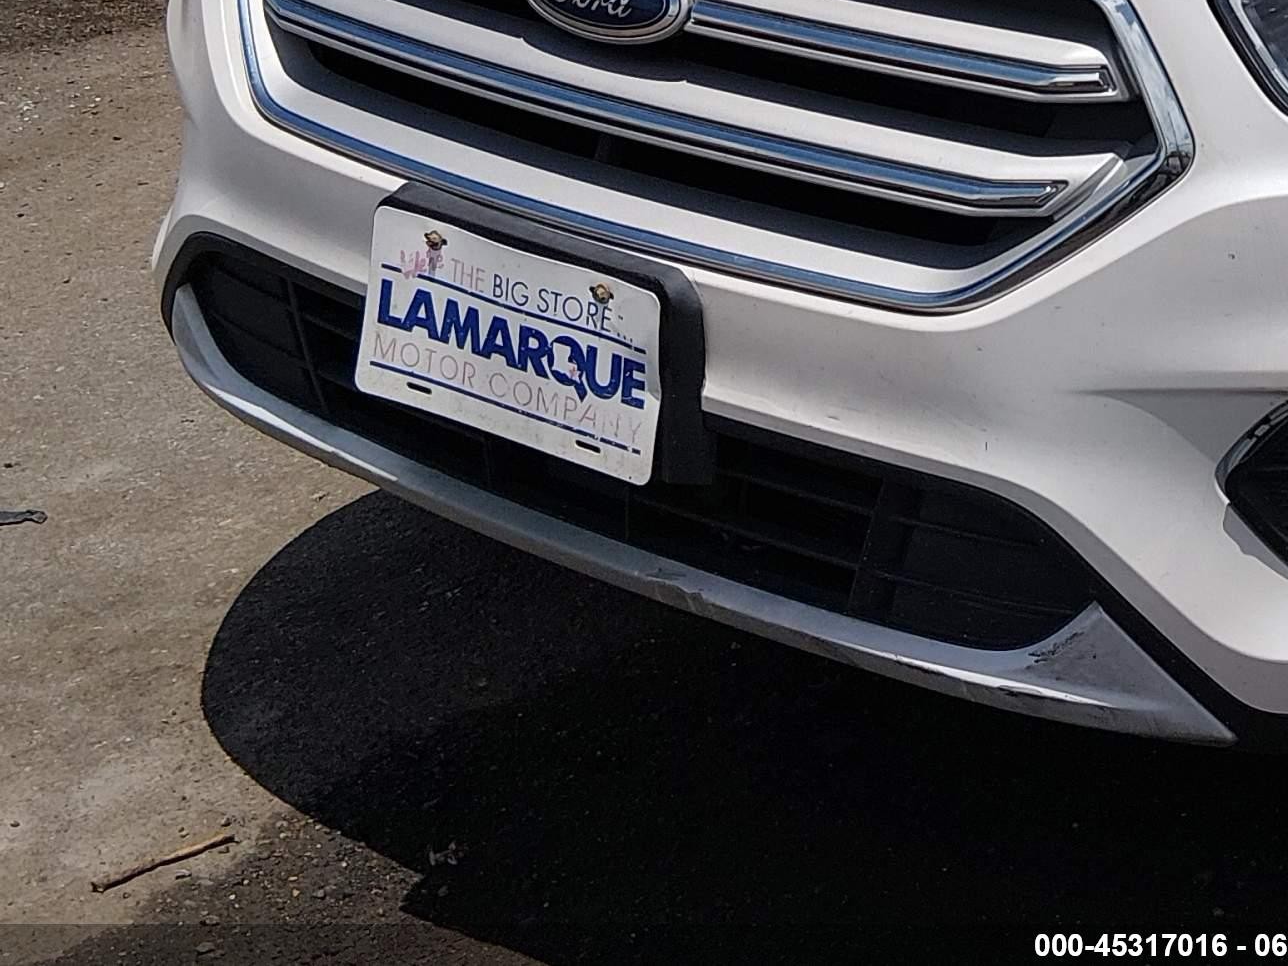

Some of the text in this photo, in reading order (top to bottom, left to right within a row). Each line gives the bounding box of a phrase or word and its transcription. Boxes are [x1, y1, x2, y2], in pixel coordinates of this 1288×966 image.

[451, 258, 485, 293] THE
[493, 273, 529, 307] BIG
[374, 333, 642, 445] MOTOR COMPANY
[377, 278, 647, 409] LAMARQUE
